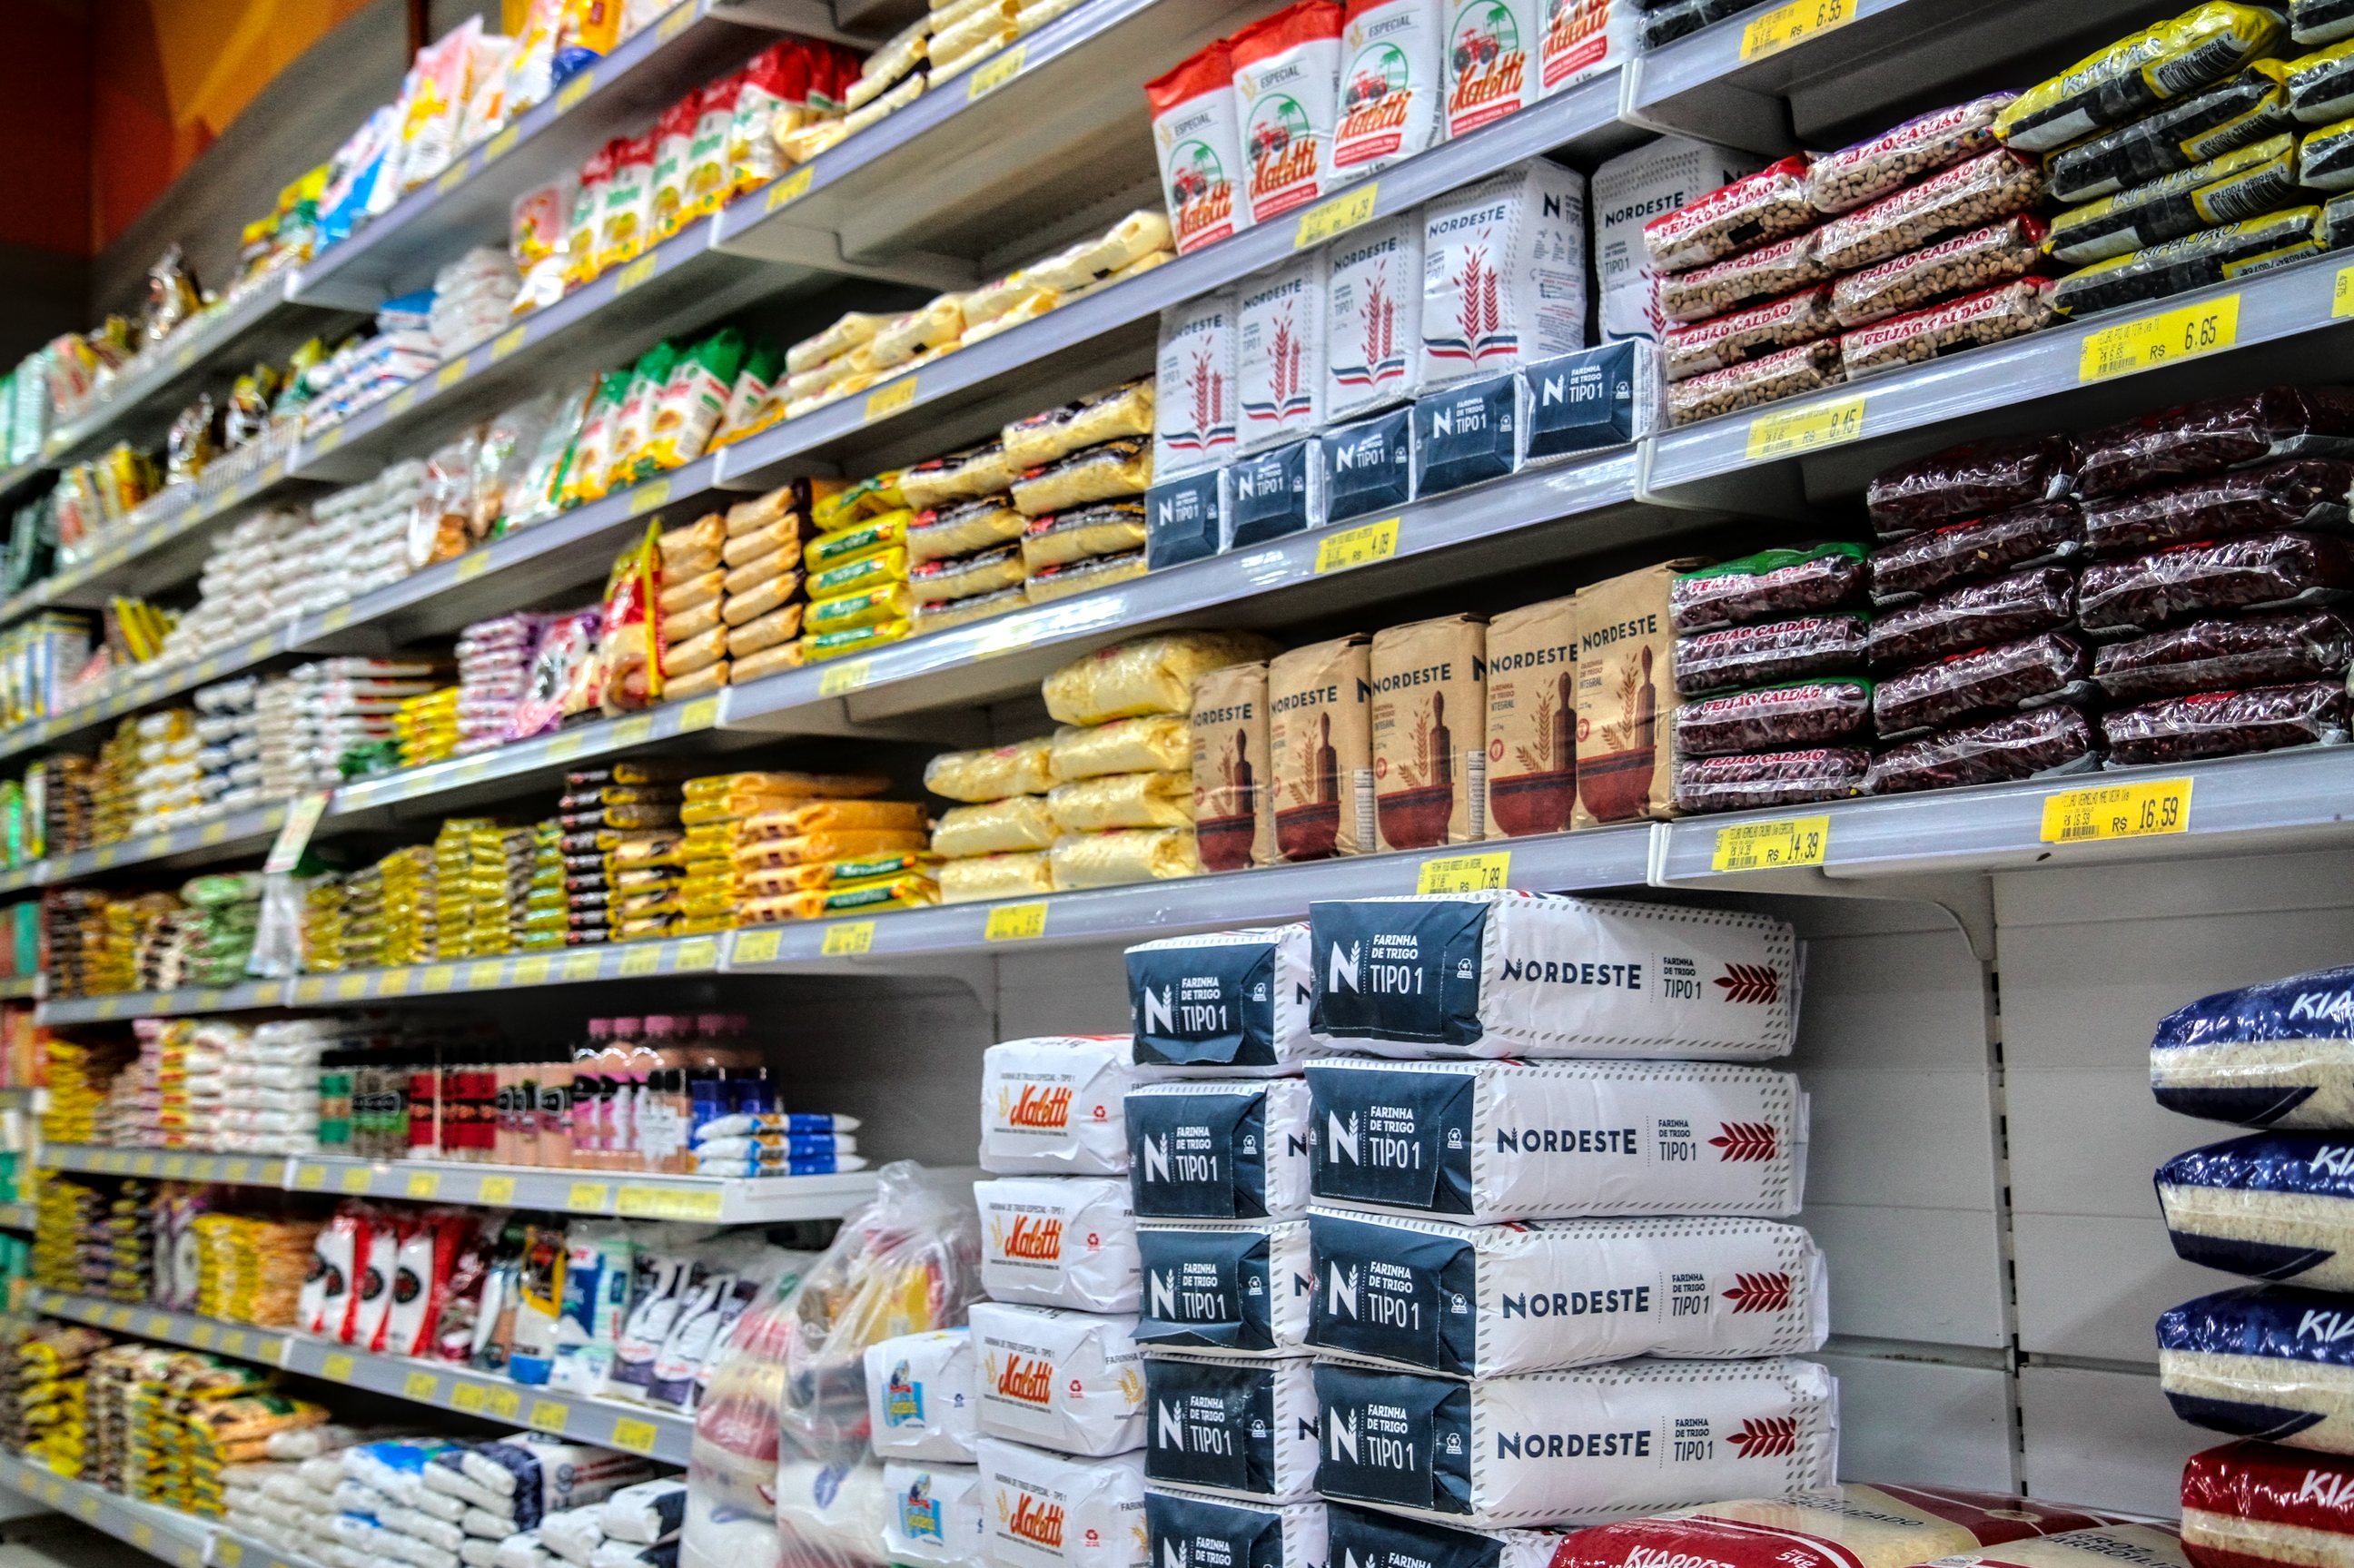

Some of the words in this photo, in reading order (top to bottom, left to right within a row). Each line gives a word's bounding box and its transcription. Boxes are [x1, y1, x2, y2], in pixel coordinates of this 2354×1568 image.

[1369, 15, 1411, 38] ESPECIAL
[1260, 65, 1300, 89] ESPECIAL
[1174, 113, 1212, 136] ESPECIAL
[1606, 192, 1685, 228] NORDESTE
[1428, 205, 1506, 239] NORDESTE
[1333, 237, 1397, 272] NORDESTE
[1243, 278, 1302, 311] NORDESTE
[1570, 377, 1578, 385] DE
[1579, 372, 1602, 383] TRIGO
[1571, 364, 1601, 378] FARINHA
[1569, 385, 1595, 403] TIPO
[1596, 382, 1603, 399] 1
[1456, 416, 1479, 435] TIPO
[1479, 413, 1487, 429] 1
[1356, 449, 1376, 467] TIPO
[1378, 448, 1385, 463] 1
[1582, 614, 1657, 653] NORDESTE
[1489, 643, 1578, 675] NORDESTE
[1372, 663, 1452, 695] NORDESTE
[1271, 685, 1338, 715] NORDESTE
[2112, 816, 2128, 833] R$
[1373, 934, 1418, 947] FARINHA
[1371, 947, 1384, 959] DE
[1385, 949, 1419, 960] TRIGO
[1663, 956, 1694, 967] FARINHA
[1370, 964, 1408, 994] TIPO
[1414, 967, 1423, 995] 1
[1500, 958, 1642, 990] NORDESTE
[1663, 966, 1676, 975] DE
[1676, 967, 1696, 977] TRIGO
[1182, 977, 1220, 989] FARINHA
[1663, 979, 1693, 999] TIPO
[1695, 981, 1701, 1000] 1
[1182, 990, 1192, 1001] DE
[1192, 990, 1221, 1000] TRIGO
[1181, 1005, 1216, 1031] TIPO
[1220, 1005, 1227, 1031] 1
[1370, 1106, 1414, 1120] FARINHA
[1176, 1127, 1210, 1137] FARINHA
[1370, 1119, 1383, 1131] DE
[1383, 1120, 1415, 1134] TRIGO
[1658, 1119, 1689, 1129] FARINHA
[1497, 1127, 1637, 1155] NORDESTE
[1658, 1129, 1670, 1138] DE
[1671, 1129, 1691, 1138] TRIGO
[1176, 1139, 1186, 1149] DE
[1186, 1139, 1212, 1149] TRIGO
[1370, 1137, 1408, 1169] TIPO
[1411, 1141, 1419, 1169] 1
[1659, 1141, 1689, 1161] TIPO
[1691, 1142, 1697, 1161] 1
[1176, 1155, 1208, 1181] TIPO
[1210, 1155, 1218, 1181] 1
[1183, 1263, 1217, 1274] FARINHA
[1370, 1261, 1411, 1279] FARINHA
[1672, 1273, 1704, 1282] FARINHA
[1182, 1276, 1192, 1287] DE
[1193, 1277, 1218, 1287] TRIGO
[1369, 1277, 1381, 1288] DE
[1382, 1279, 1413, 1294] TRIGO
[1672, 1284, 1683, 1293] DE
[1684, 1283, 1706, 1293] TRIGO
[1182, 1292, 1215, 1319] TIPO
[1217, 1293, 1226, 1319] 1
[1368, 1293, 1408, 1327] TIPO
[1410, 1302, 1419, 1330] 1
[1502, 1286, 1650, 1320] NORDESTE
[1672, 1296, 1701, 1317] TIPO
[1702, 1295, 1710, 1315] 1
[1190, 1395, 1224, 1409] FARINHA
[1190, 1409, 1201, 1420] DE
[1201, 1411, 1225, 1423] TRIGO
[1368, 1404, 1408, 1420] FARINHA
[1367, 1418, 1379, 1430] DE
[1380, 1420, 1408, 1435] TRIGO
[1675, 1418, 1709, 1427] FARINHA
[1190, 1425, 1222, 1455] TIPO
[1223, 1430, 1232, 1456] 1
[1675, 1429, 1685, 1438] DE
[1686, 1427, 1709, 1437] TRIGO
[1366, 1435, 1403, 1470] TIPO
[1406, 1443, 1414, 1472] 1
[1498, 1430, 1651, 1460] NORDESTE
[1674, 1442, 1706, 1462] TIPO
[1707, 1440, 1714, 1460] 1
[1196, 1536, 1231, 1553] FARINHA
[1195, 1550, 1207, 1562] DE
[1207, 1552, 1231, 1566] TRIGO
[1389, 1552, 1432, 1568] FARINHA
